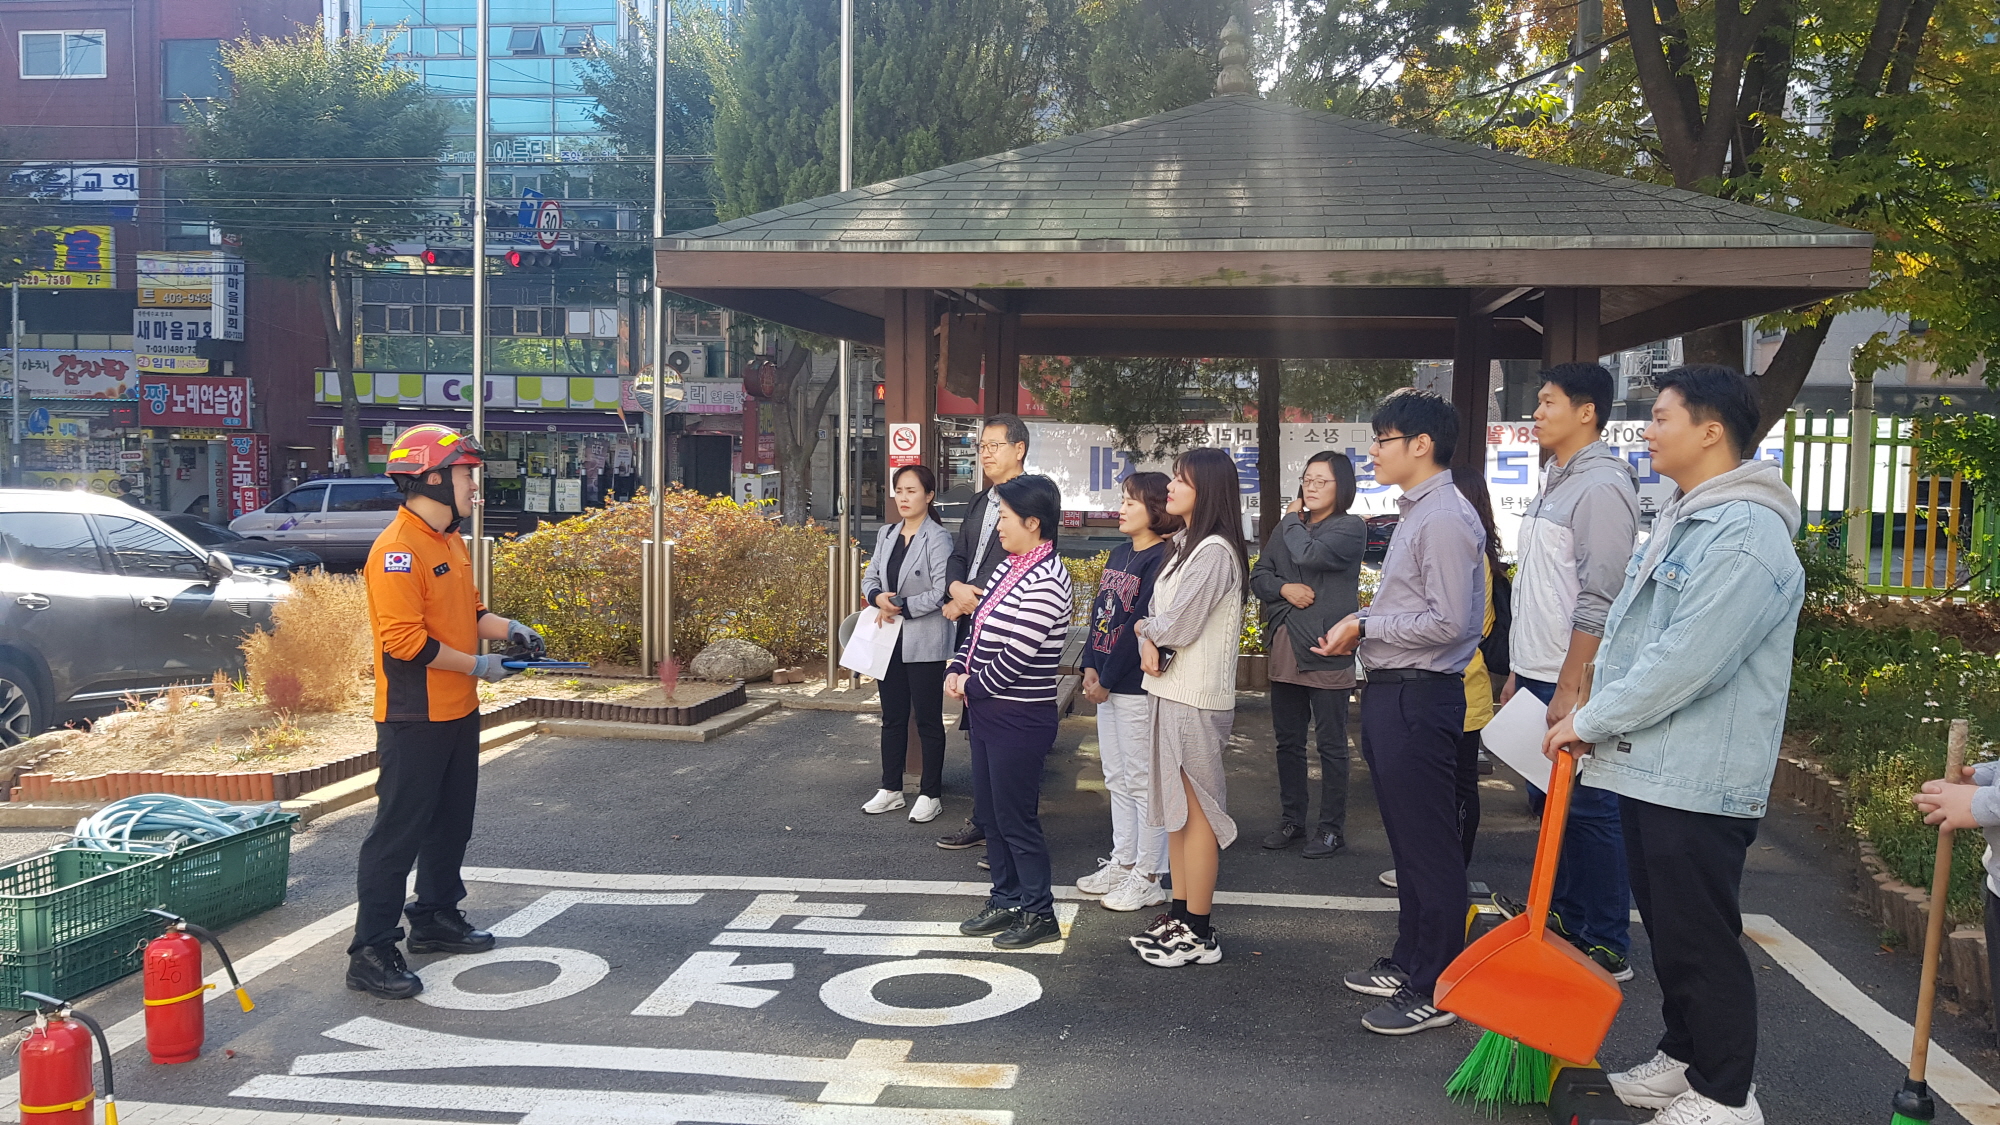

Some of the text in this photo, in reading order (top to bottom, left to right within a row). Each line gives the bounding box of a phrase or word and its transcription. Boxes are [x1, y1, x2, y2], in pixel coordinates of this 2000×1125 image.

[543, 211, 558, 237] 30
[87, 274, 101, 286] 2F
[152, 358, 176, 369] 임대
[143, 383, 244, 416] 짱 노래연습장
[230, 437, 253, 455] 짱
